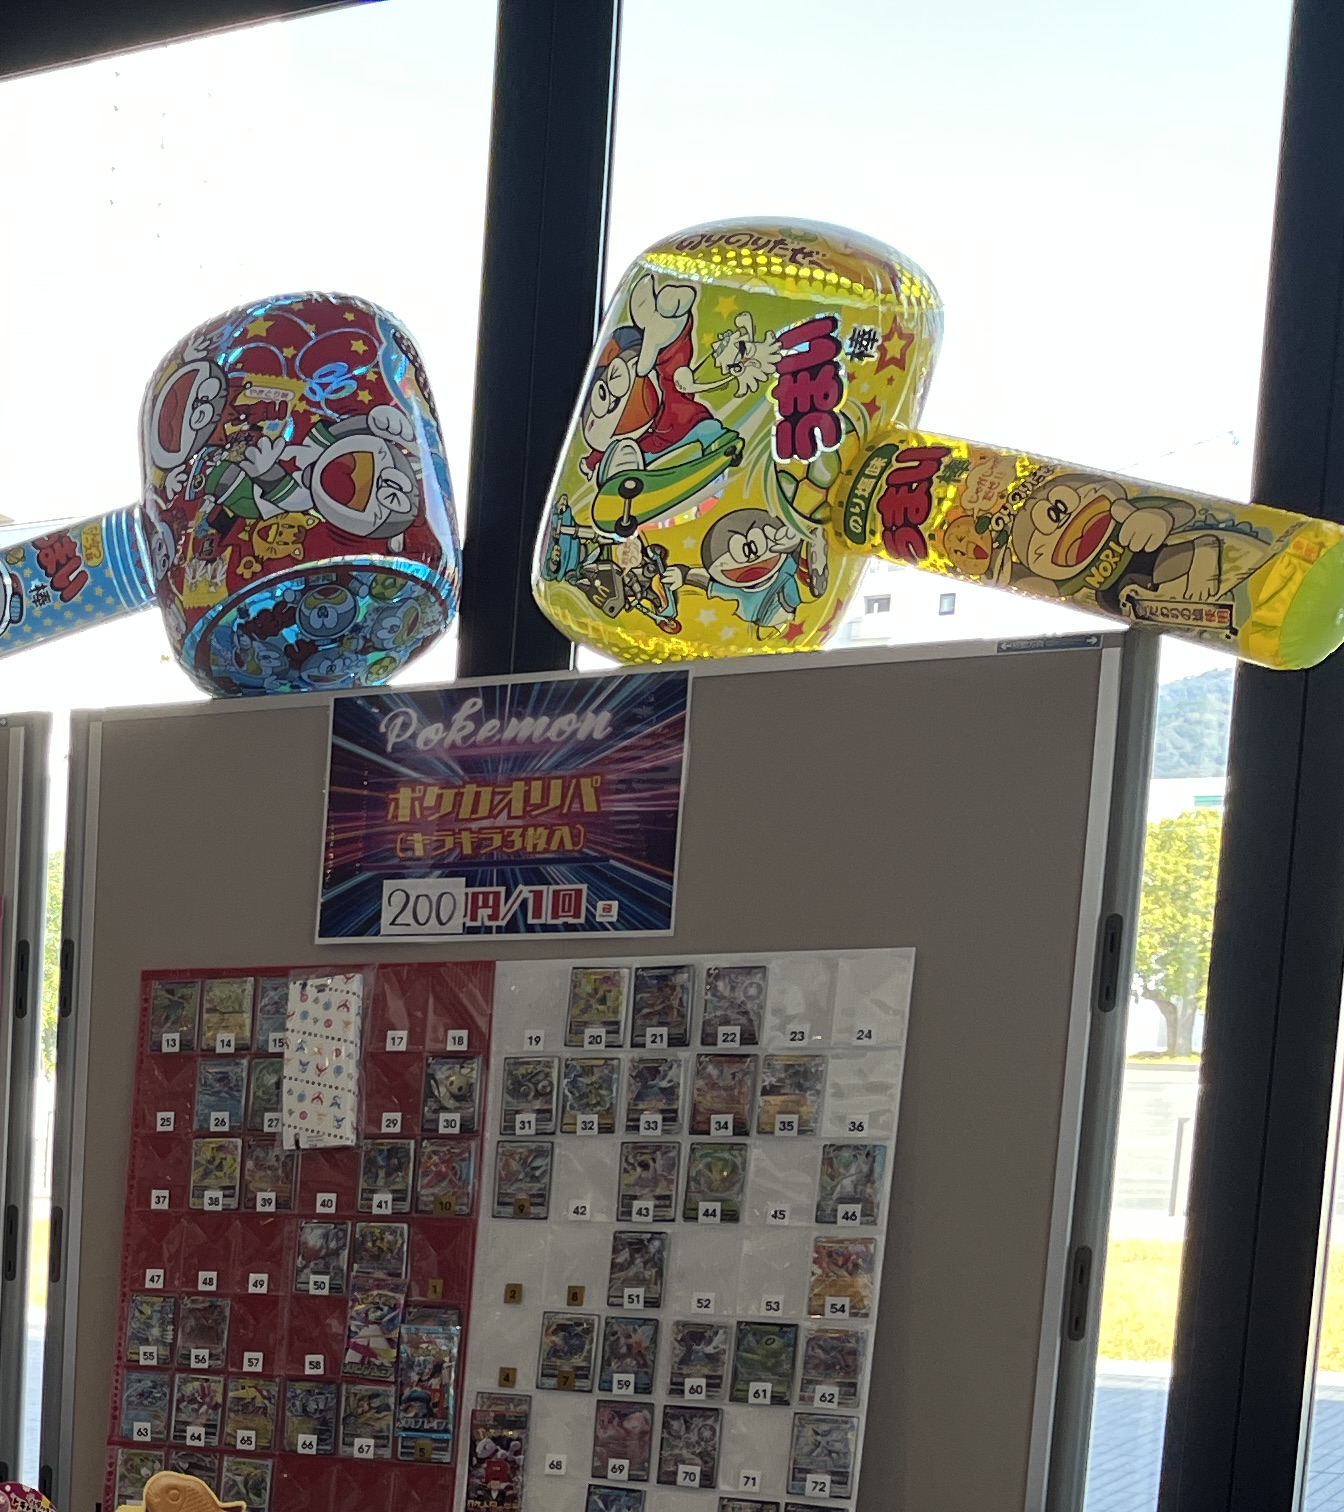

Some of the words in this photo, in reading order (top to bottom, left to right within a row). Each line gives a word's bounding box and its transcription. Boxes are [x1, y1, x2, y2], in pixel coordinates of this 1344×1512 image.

[848, 455, 889, 535] のり塩味
[1085, 540, 1125, 589] NORI
[379, 697, 611, 754] Pokemon
[386, 774, 602, 825] ポケカオリパ
[527, 1035, 542, 1046] 19
[587, 1034, 603, 1045] 20
[650, 1033, 664, 1045] 21
[721, 1031, 737, 1043] 22
[789, 1030, 805, 1042] 23
[855, 1029, 873, 1041] 24
[165, 1037, 177, 1049] 13
[219, 1038, 232, 1049] 14
[390, 1036, 404, 1047] 17
[451, 1035, 465, 1047] 18
[159, 1117, 172, 1127] 25
[213, 1117, 227, 1127] 26
[385, 1118, 399, 1129] 29
[443, 1118, 457, 1129] 30
[519, 1119, 532, 1131] 31
[580, 1120, 595, 1131] 32
[778, 1120, 795, 1132] 35
[848, 1121, 865, 1133] 36
[154, 1195, 167, 1205] 37
[207, 1196, 221, 1207] 38
[260, 1197, 273, 1208] 39
[319, 1198, 334, 1209] 40
[376, 1199, 389, 1210] 41
[572, 1205, 587, 1216] 42
[635, 1206, 650, 1218] 43
[701, 1207, 717, 1219] 44
[841, 1210, 858, 1222] 46
[148, 1274, 162, 1284] 47
[201, 1276, 214, 1287] 48
[251, 1279, 265, 1289] 49
[313, 1280, 327, 1291] 50
[627, 1293, 641, 1305] 51
[696, 1297, 711, 1309] 52
[829, 1303, 846, 1314] 54
[142, 1351, 155, 1361] 55
[194, 1354, 207, 1365] 56
[308, 1360, 322, 1371] 58
[617, 1379, 631, 1391] 59
[688, 1384, 703, 1395] 60
[752, 1388, 767, 1400] 61
[819, 1392, 835, 1404] 62
[136, 1427, 149, 1437] 63
[189, 1432, 202, 1443] 64
[239, 1435, 253, 1446] 65
[357, 1443, 372, 1455] 67
[548, 1459, 563, 1471] 68
[610, 1463, 625, 1475] 69
[682, 1470, 697, 1483] 70
[743, 1475, 757, 1487] 71
[811, 1480, 827, 1493] 72
